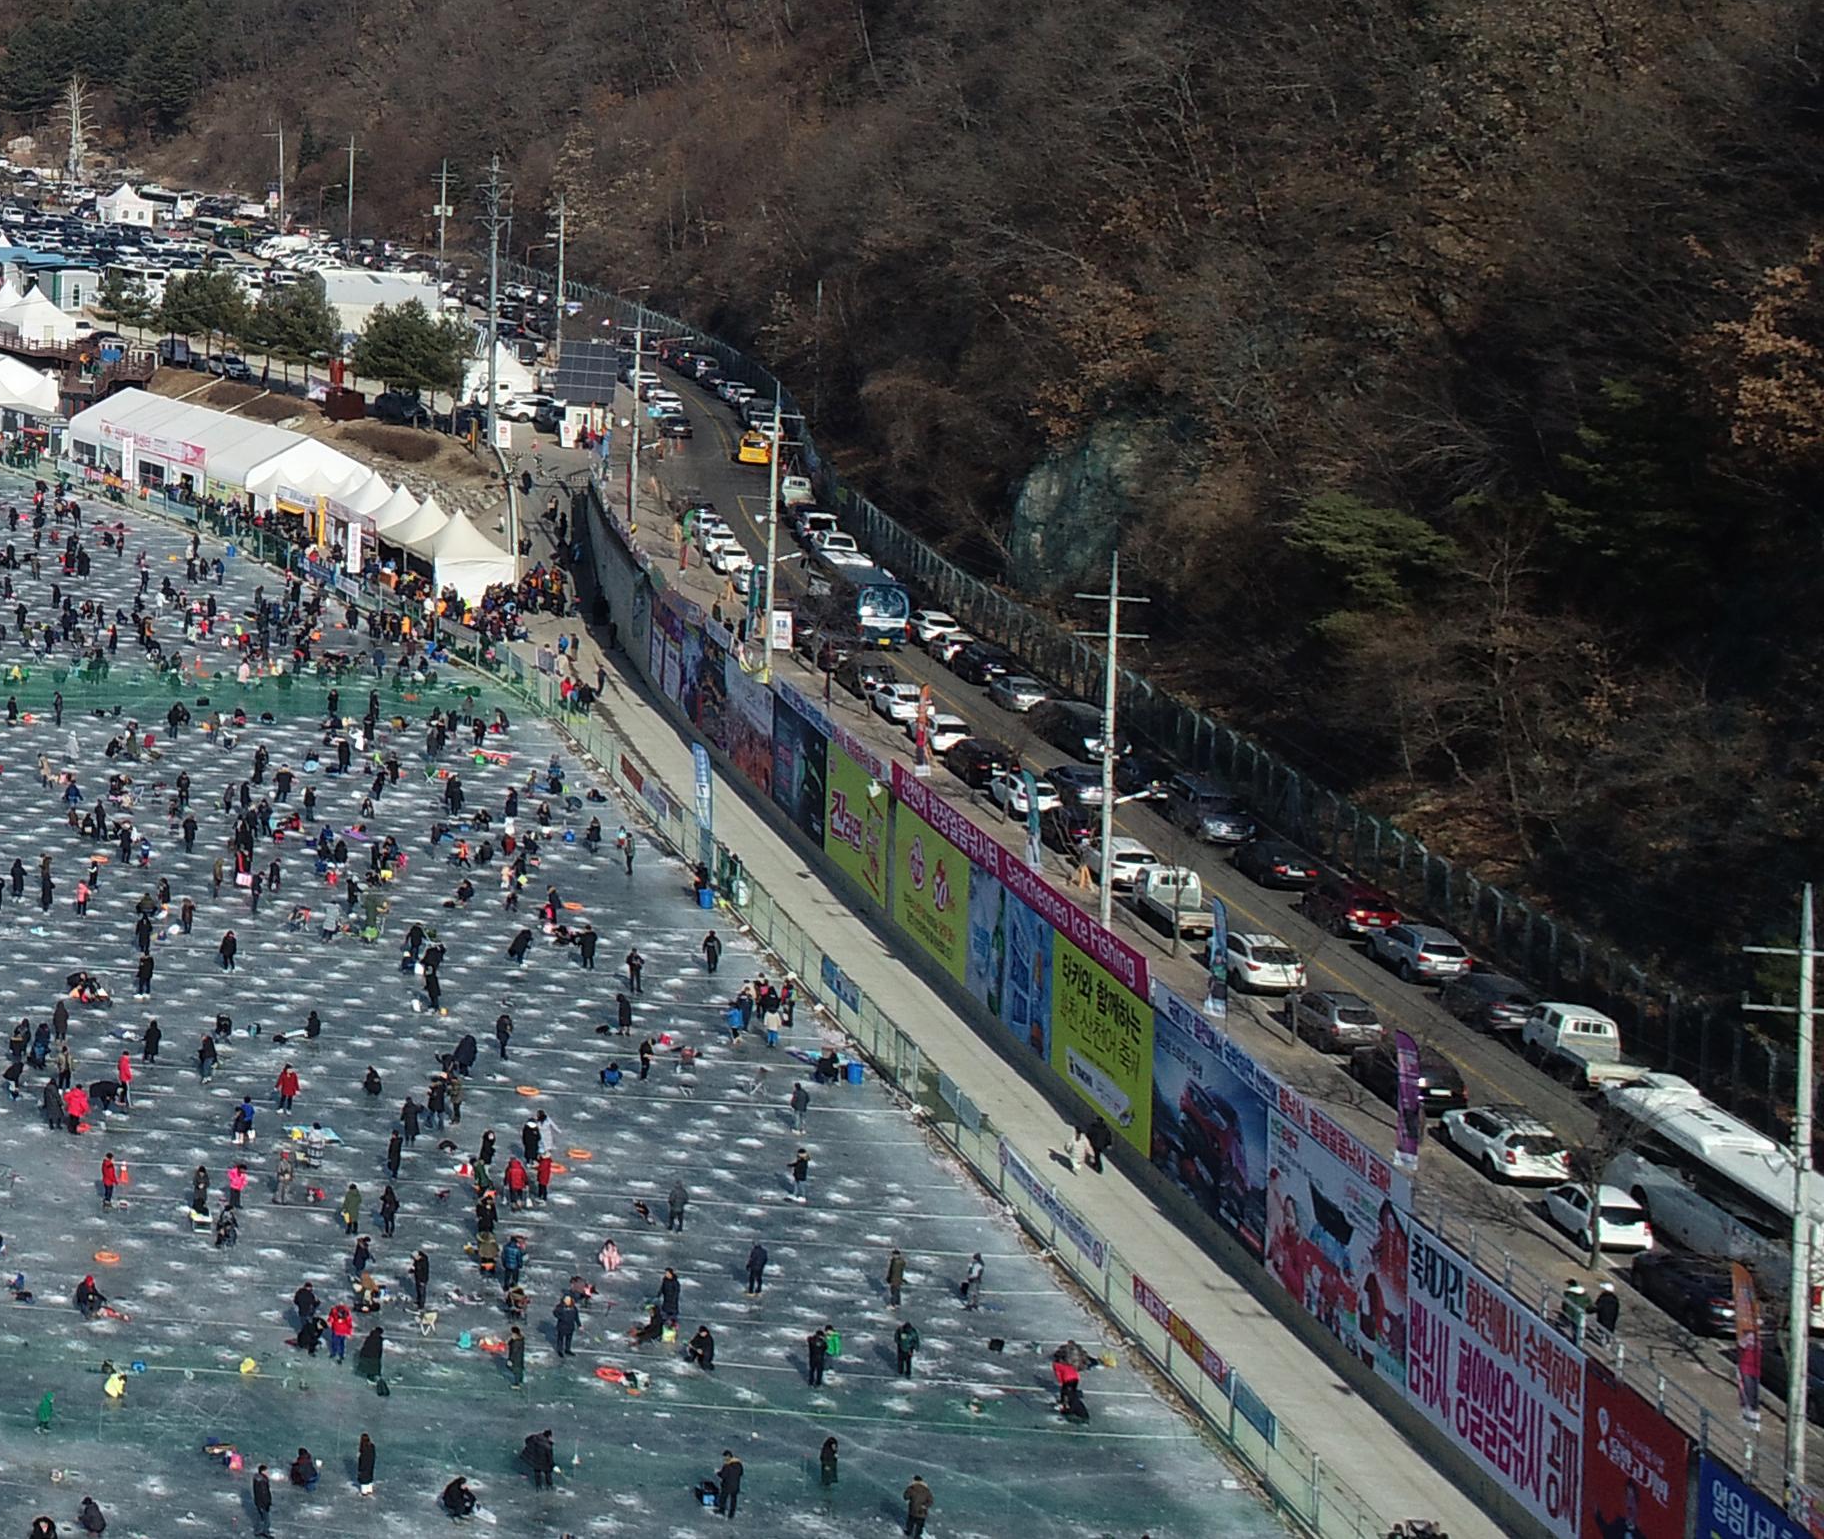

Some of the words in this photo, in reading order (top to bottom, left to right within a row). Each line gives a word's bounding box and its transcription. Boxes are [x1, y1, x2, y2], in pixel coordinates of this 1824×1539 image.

[1070, 907, 1089, 944] Ice
[1090, 923, 1136, 988] Fishing
[1079, 1006, 1117, 1063] 산천어
[1118, 1034, 1140, 1082] 축제
[1095, 978, 1142, 1046] 함께하는
[1410, 1232, 1465, 1321] 축제기간
[1466, 1276, 1522, 1361] 화천에서
[1522, 1328, 1581, 1418] 숙박하면
[1456, 1338, 1545, 1503] 평일얼음낚시
[1545, 1412, 1579, 1528] 공짜
